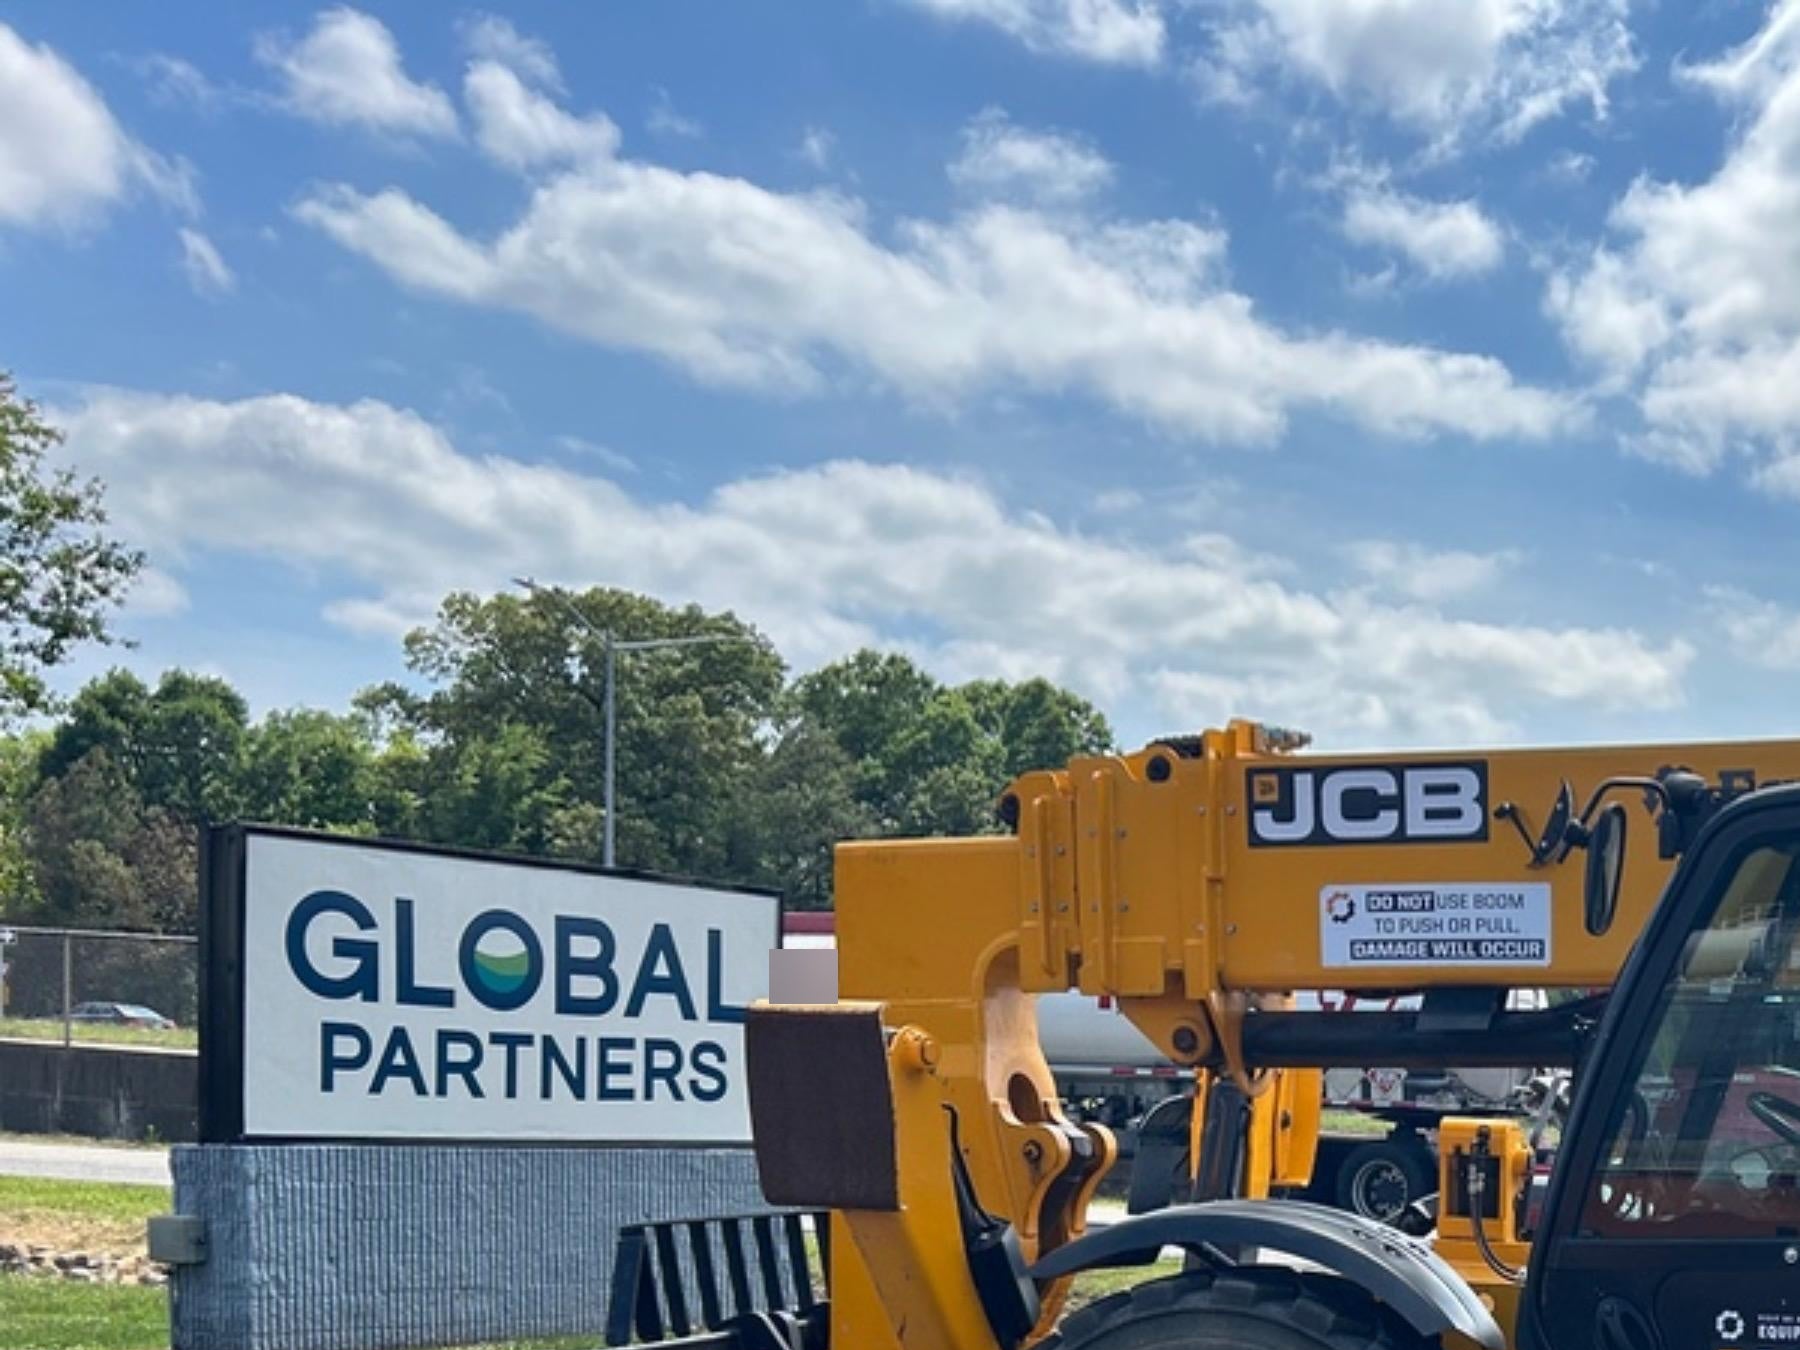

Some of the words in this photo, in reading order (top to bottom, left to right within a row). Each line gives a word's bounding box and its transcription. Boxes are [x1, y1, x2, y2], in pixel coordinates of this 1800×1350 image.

[1253, 768, 1484, 841] JCB
[1369, 892, 1392, 911] DO
[1397, 892, 1433, 911] NOT
[1436, 892, 1470, 910] USE
[1473, 892, 1525, 910] BOOM
[1374, 917, 1396, 935] TO
[1400, 917, 1445, 934] PUSH
[1448, 917, 1472, 934] OR
[285, 890, 750, 1025] GLOBAL
[1352, 941, 1428, 959] DAMAGE
[1431, 941, 1477, 958] WILL
[1480, 941, 1543, 959] OCCUR
[320, 1021, 728, 1102] PARTNERS
